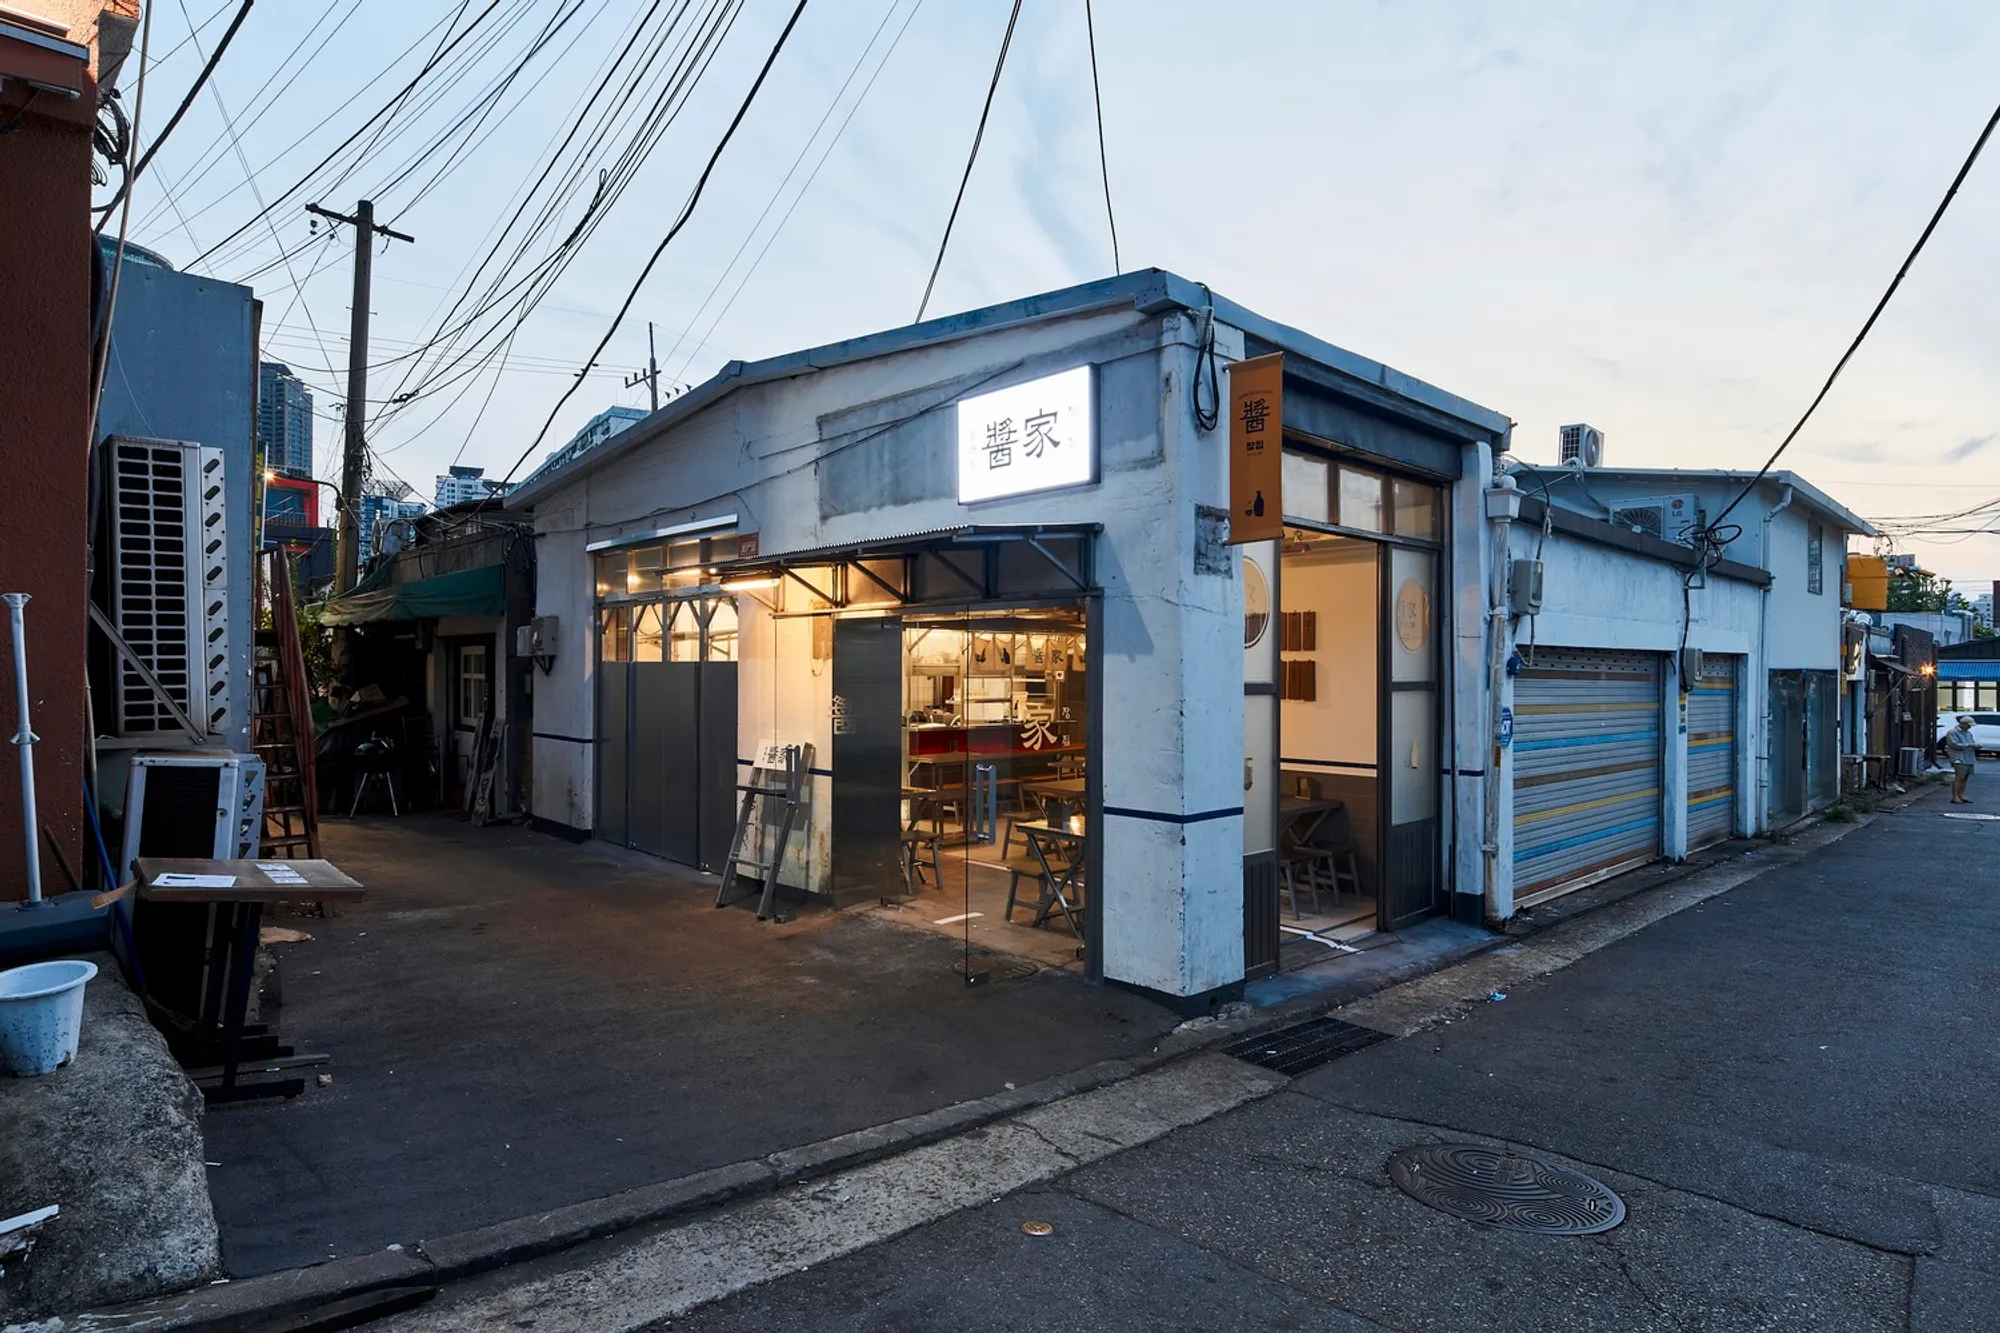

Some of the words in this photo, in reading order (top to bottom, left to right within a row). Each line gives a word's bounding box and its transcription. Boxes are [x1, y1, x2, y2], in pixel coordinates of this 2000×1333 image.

[981, 407, 1061, 470] 醬家
[1239, 398, 1271, 434] 醬
[1020, 704, 1057, 751] 家
